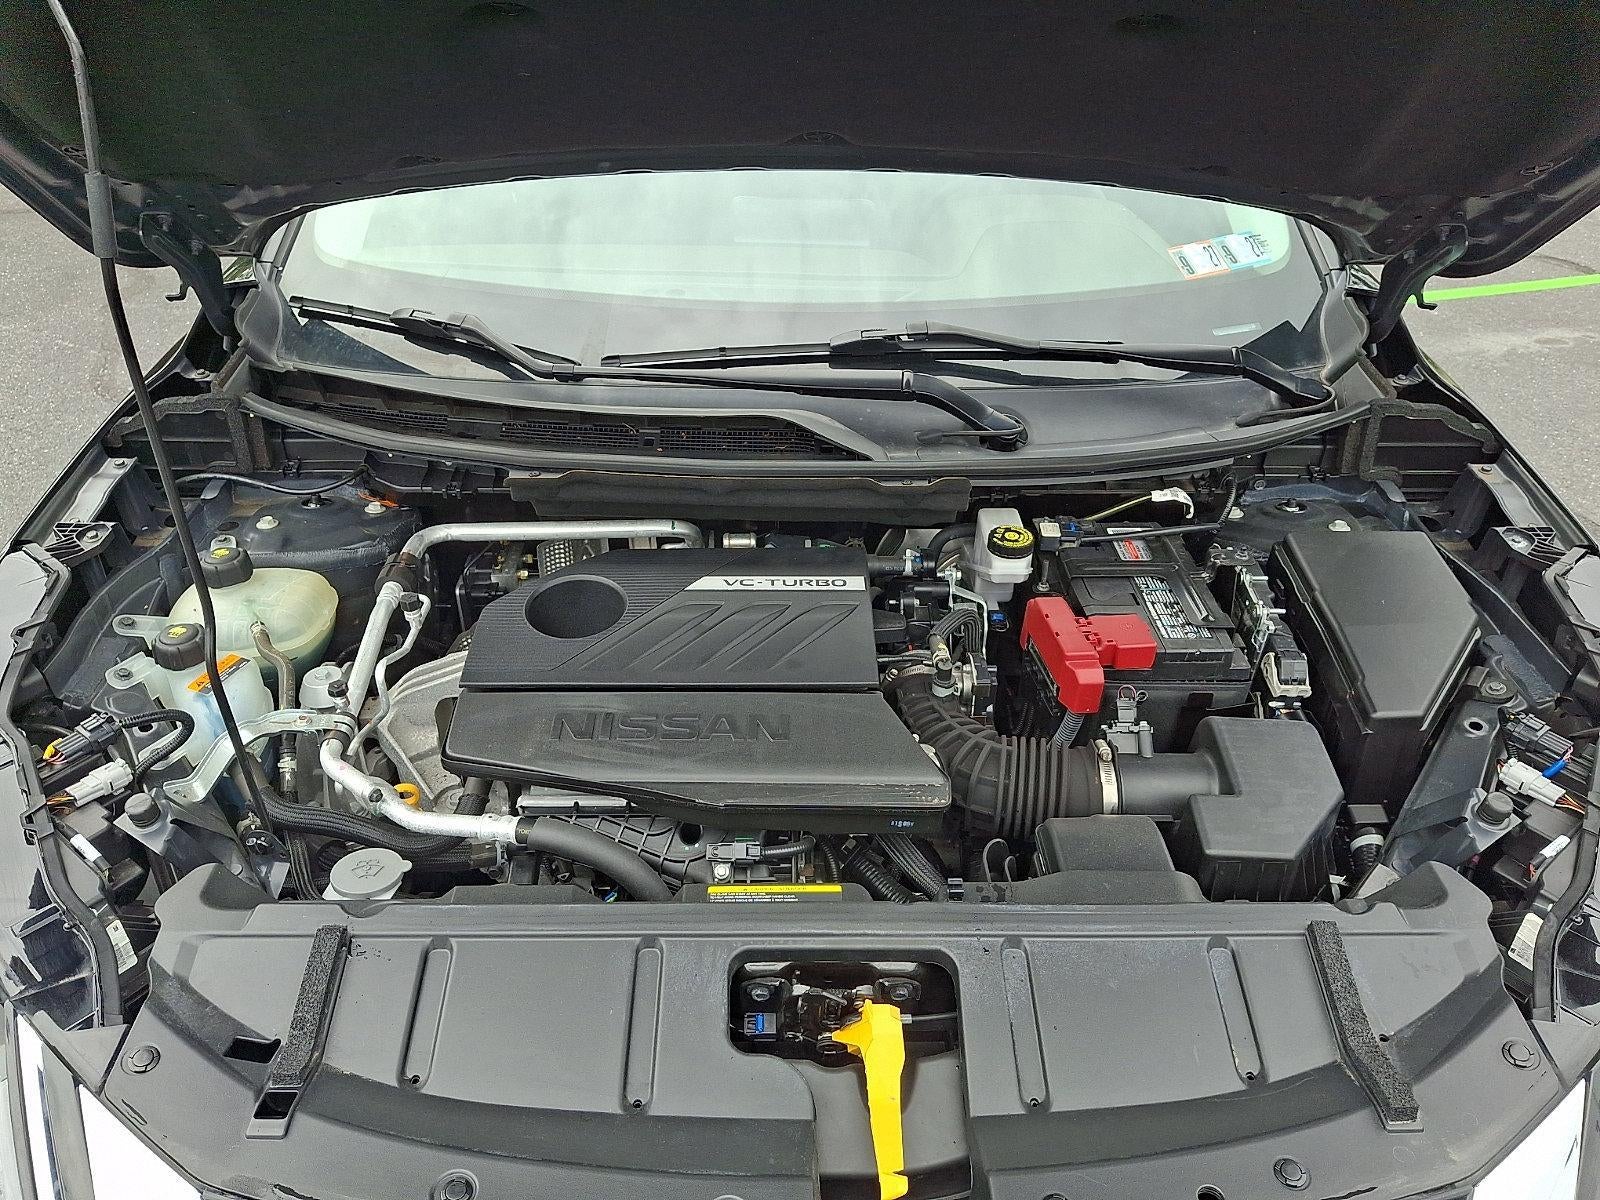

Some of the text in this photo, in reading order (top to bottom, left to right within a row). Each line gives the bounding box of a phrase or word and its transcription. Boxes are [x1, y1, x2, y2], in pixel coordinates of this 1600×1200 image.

[1221, 245, 1238, 264] 9
[1178, 255, 1195, 275] 9
[723, 578, 848, 588] VC-TURBO
[549, 711, 791, 743] NISSAN
